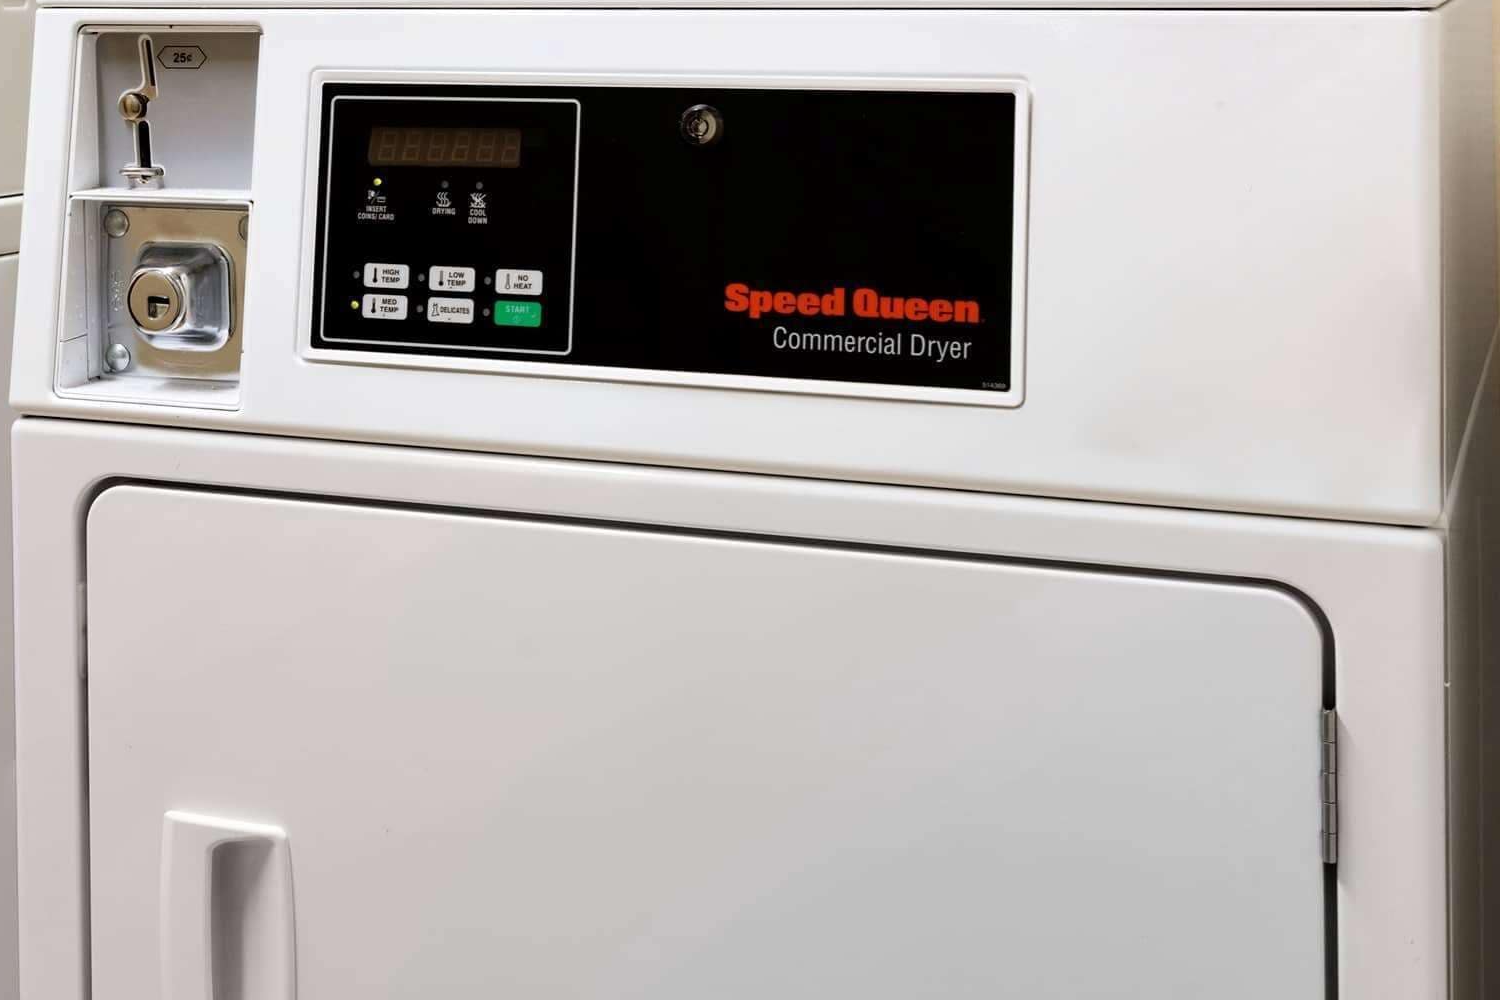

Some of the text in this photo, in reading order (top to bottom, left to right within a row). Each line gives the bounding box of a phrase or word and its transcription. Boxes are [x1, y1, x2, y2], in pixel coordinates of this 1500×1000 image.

[173, 52, 193, 63] 25¢
[432, 207, 456, 215] DRYING
[469, 208, 486, 216] COOL
[448, 271, 465, 279] LOW
[724, 283, 980, 324] Speed Queen
[440, 306, 470, 315] DELICATES
[505, 305, 530, 313] START
[773, 326, 972, 363] Commercial Dryer
